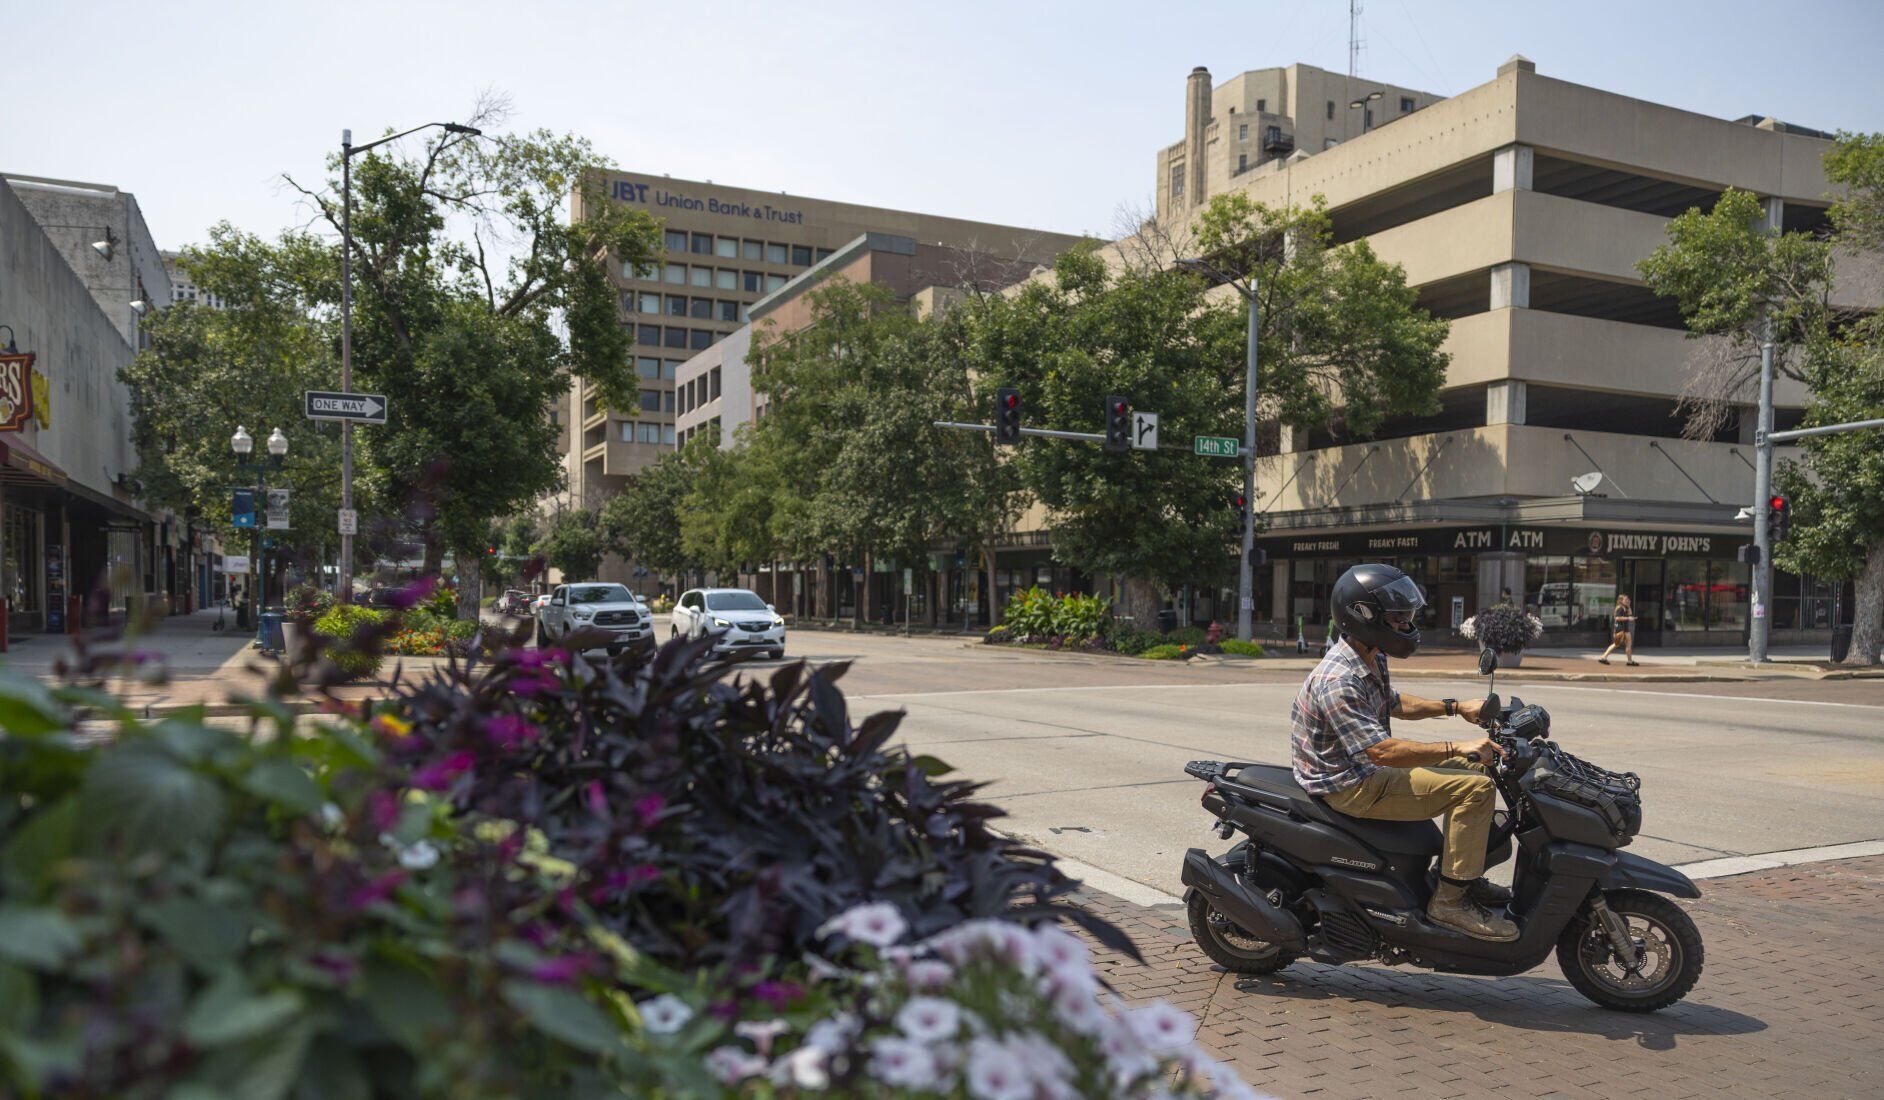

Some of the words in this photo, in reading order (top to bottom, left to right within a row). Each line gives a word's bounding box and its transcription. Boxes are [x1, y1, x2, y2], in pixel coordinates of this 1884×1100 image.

[656, 191, 704, 211] Union
[709, 199, 750, 217] Bank
[754, 208, 762, 219] &
[764, 206, 803, 225] Trust
[315, 400, 338, 410] ONE
[342, 402, 364, 411] WAY
[1200, 439, 1220, 453] 14th
[1224, 440, 1234, 454] St
[1293, 542, 1316, 552] FREAKY
[1369, 538, 1395, 549] FREAKY
[1397, 537, 1418, 548] FAST!
[1454, 531, 1491, 548] ATM
[1509, 530, 1544, 548] ATM
[1607, 534, 1657, 553] JIMMY
[1661, 536, 1710, 555] JOHN'S
